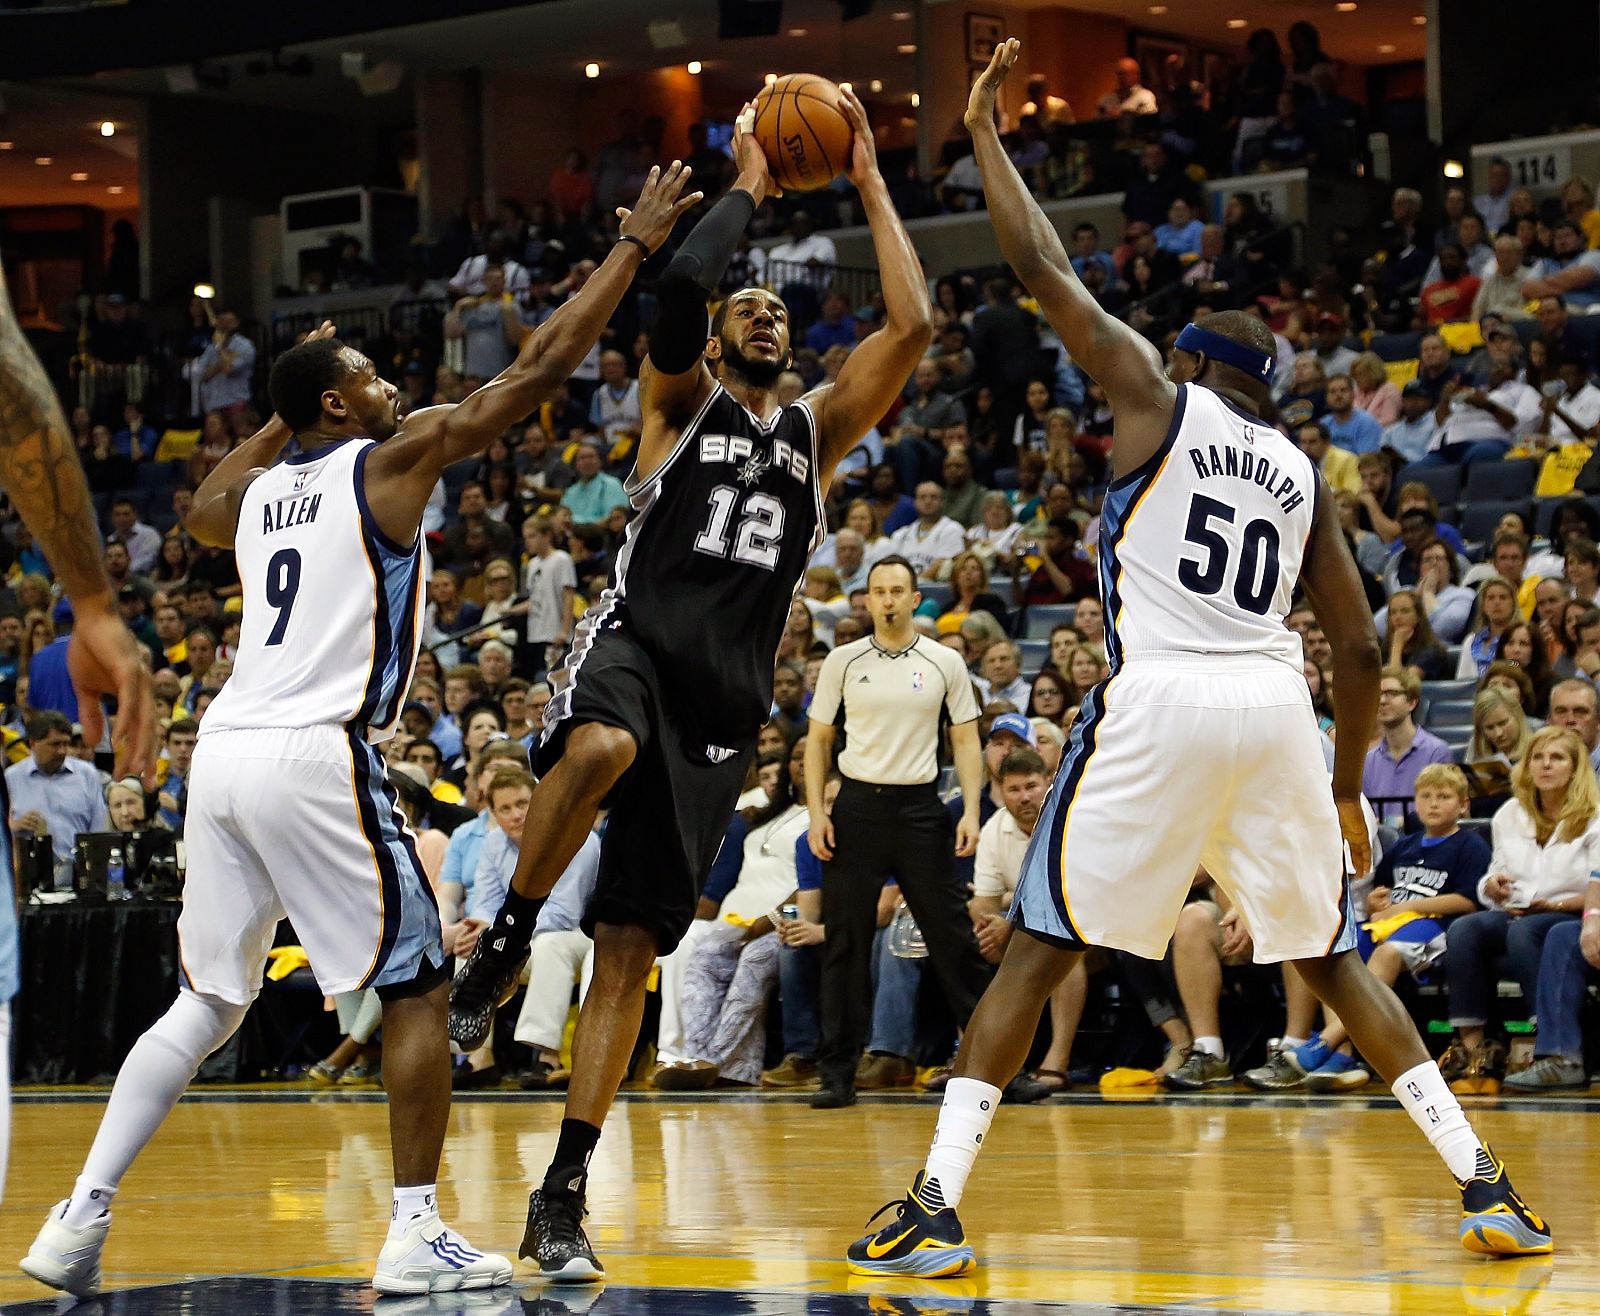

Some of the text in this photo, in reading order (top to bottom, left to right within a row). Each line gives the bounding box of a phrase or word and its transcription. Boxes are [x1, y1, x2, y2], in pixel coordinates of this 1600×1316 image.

[1518, 154, 1558, 185] 114
[263, 493, 323, 536] ALLEN
[1188, 445, 1305, 515] RANDOLPH
[693, 484, 787, 572] 12
[1177, 491, 1281, 616] 50
[266, 547, 302, 647] 9
